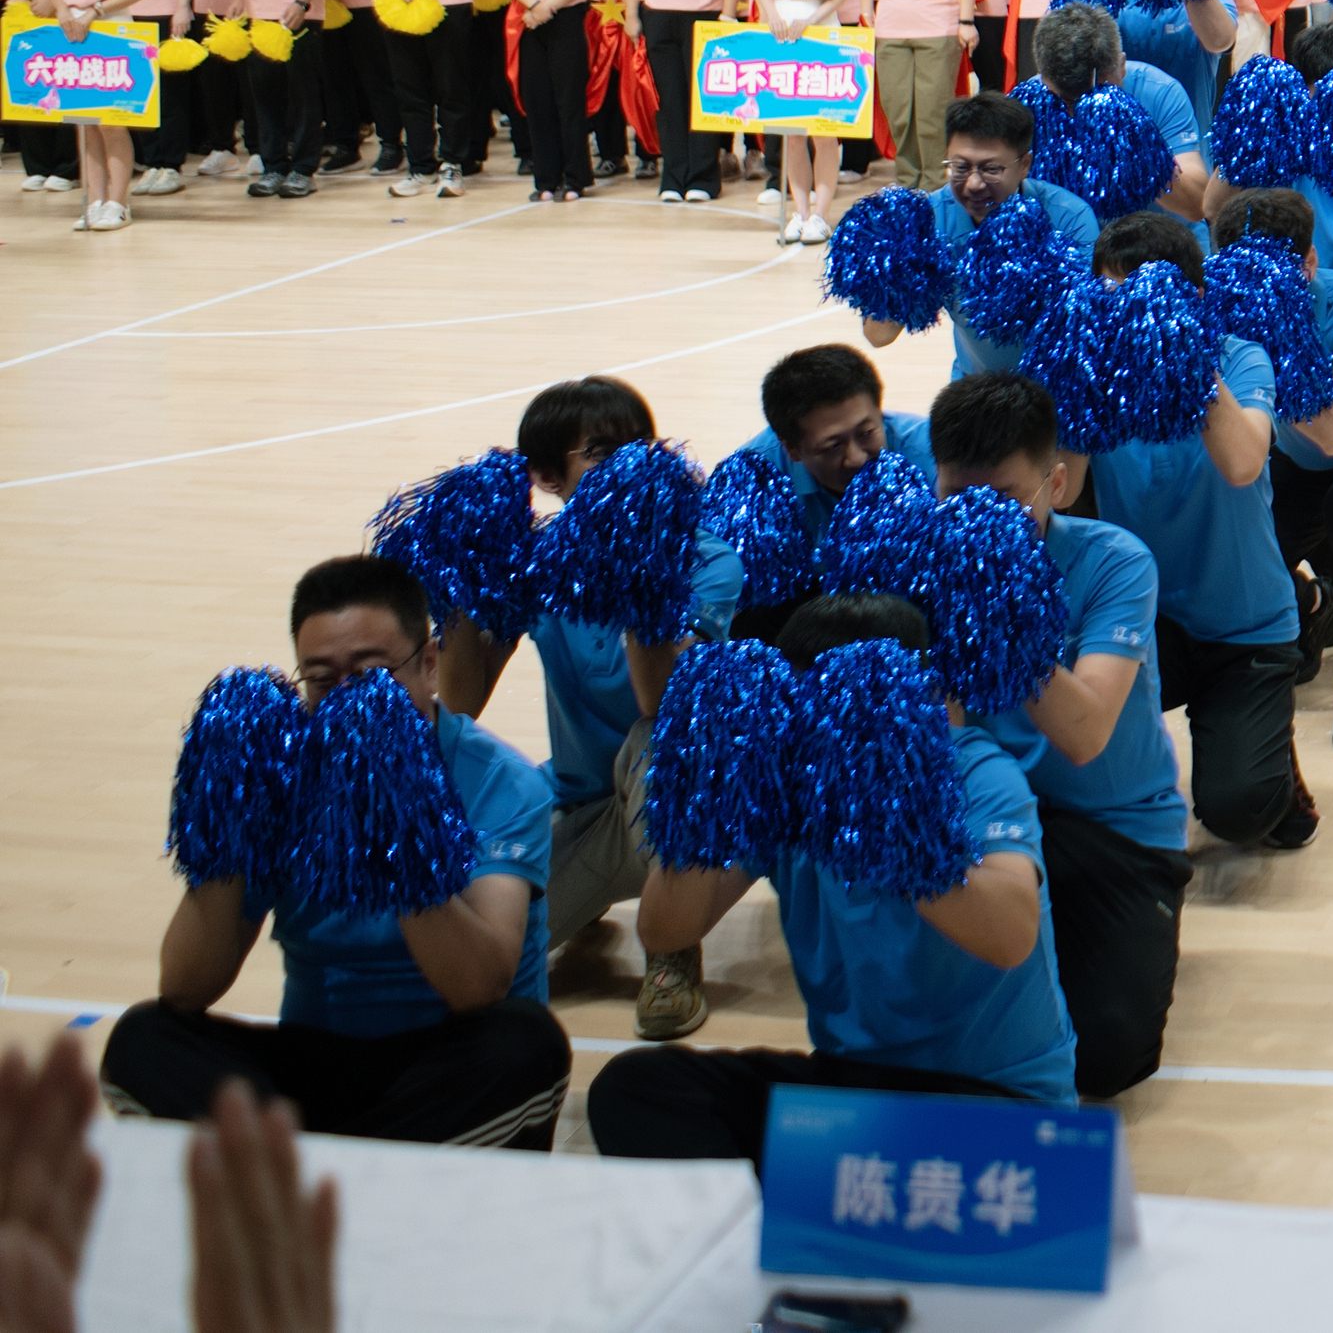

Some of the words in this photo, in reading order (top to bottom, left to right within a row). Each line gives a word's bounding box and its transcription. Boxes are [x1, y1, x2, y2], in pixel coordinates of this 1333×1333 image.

[26, 55, 134, 90] 六神战队
[706, 62, 860, 100] 四不可挡队
[832, 1152, 1038, 1237] 陈贵华
